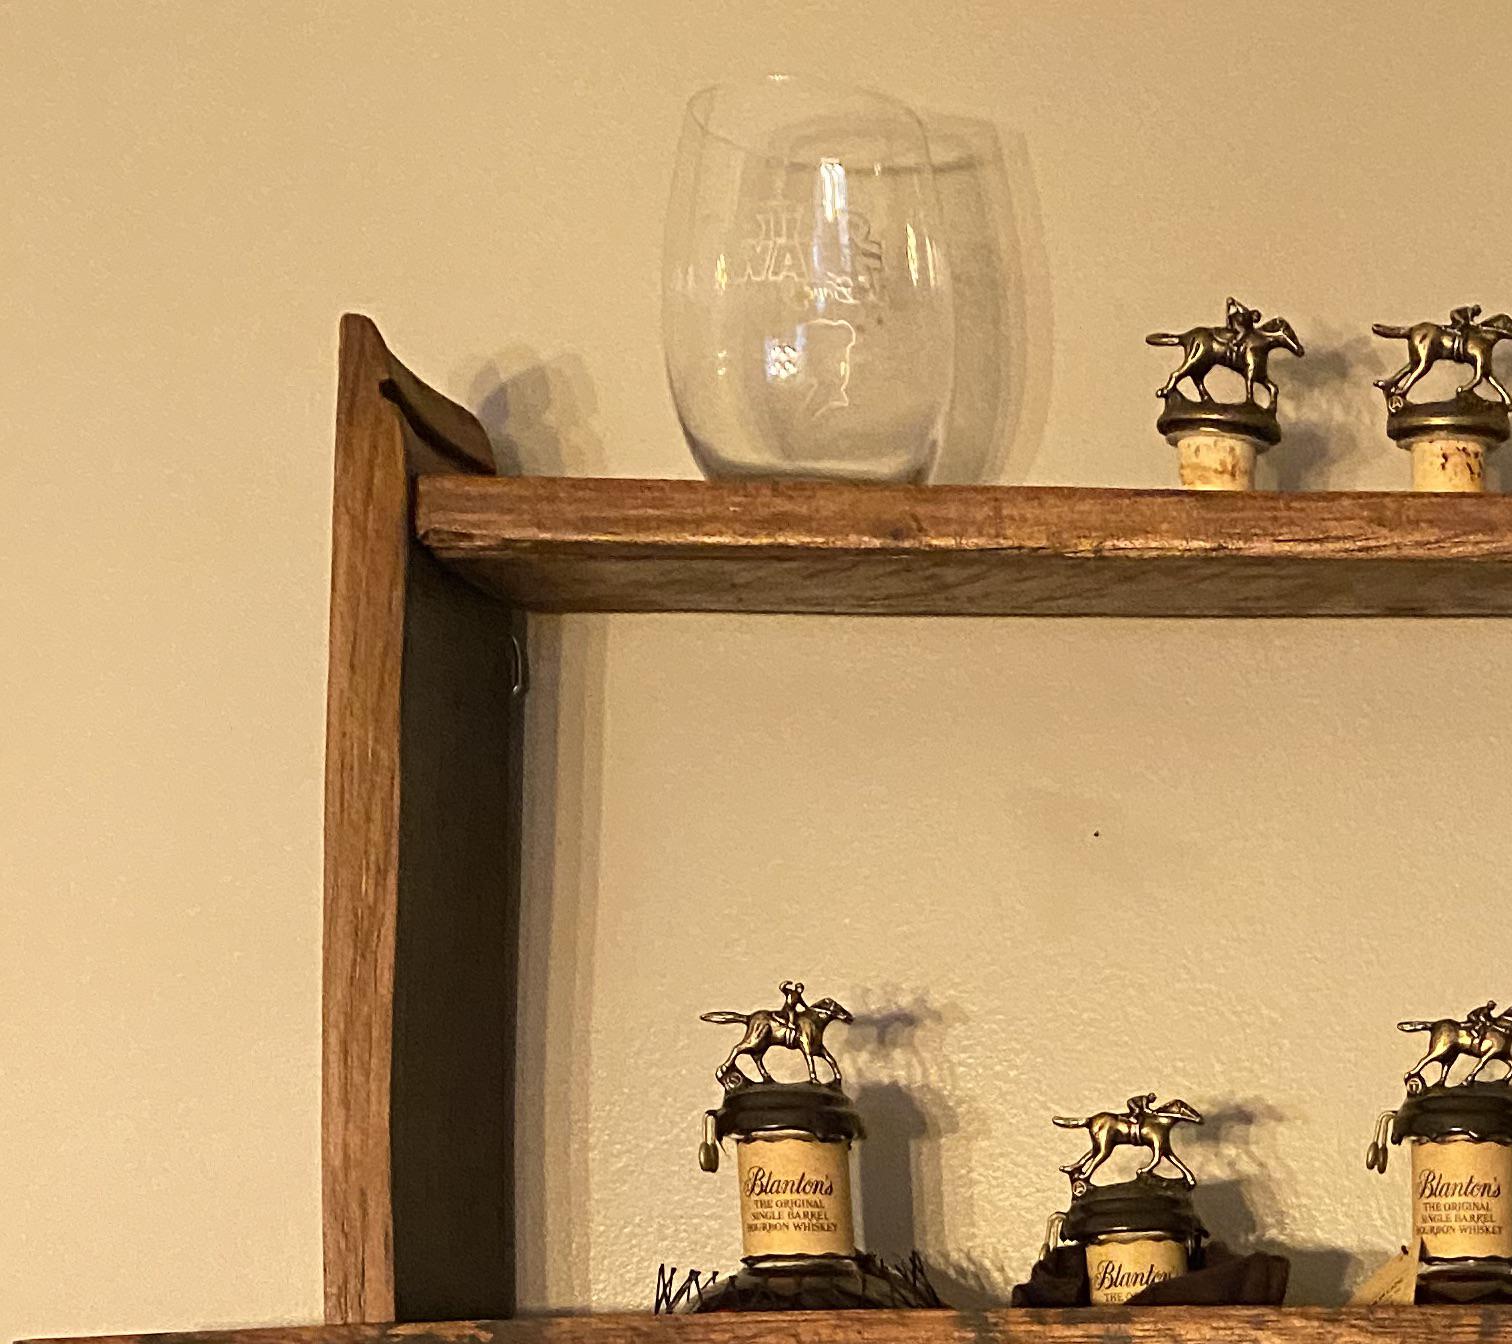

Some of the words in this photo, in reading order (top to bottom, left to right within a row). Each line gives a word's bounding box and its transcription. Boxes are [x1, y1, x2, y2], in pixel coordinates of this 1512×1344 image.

[743, 1165, 834, 1197] Blanton's
[1416, 1168, 1501, 1199] Blanton's
[754, 1199, 773, 1209] THE
[775, 1199, 825, 1211] ORIGINAL
[1422, 1202, 1442, 1212] THE
[1443, 1201, 1492, 1213] ORIGINAL
[787, 1210, 829, 1222] BARREL
[1454, 1213, 1496, 1225] BARREL
[793, 1221, 838, 1233] WHISKEY
[1094, 1260, 1171, 1291] Blanto
